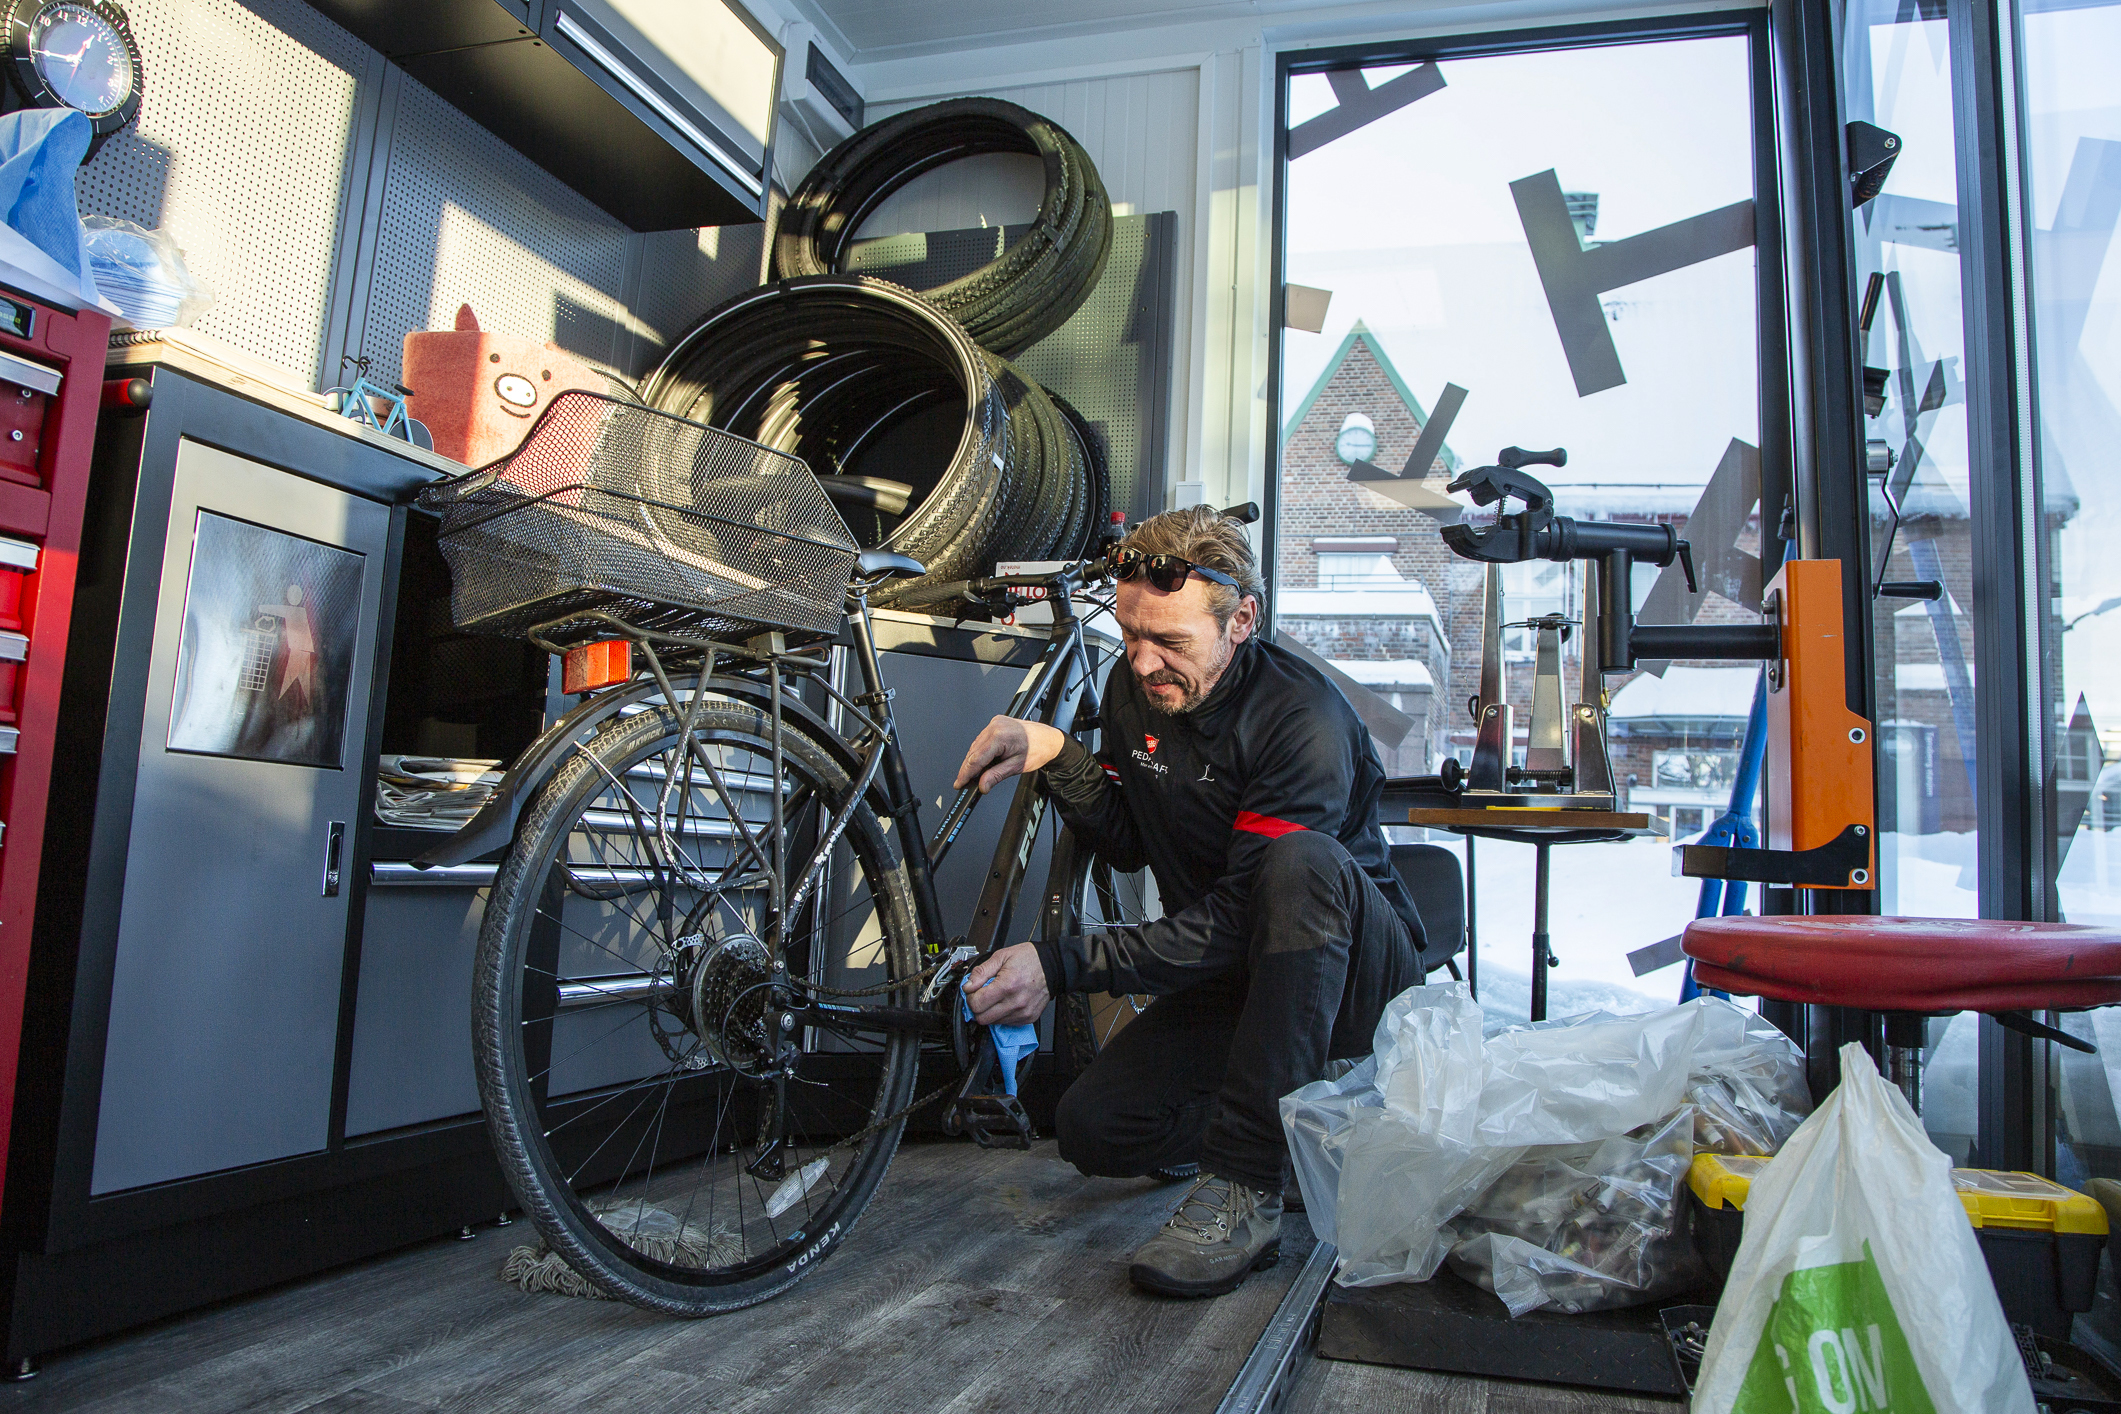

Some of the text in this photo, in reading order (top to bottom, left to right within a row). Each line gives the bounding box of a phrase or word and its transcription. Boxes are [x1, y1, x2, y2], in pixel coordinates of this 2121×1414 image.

[76, 15, 88, 27] 12
[934, 788, 969, 841] TRAVERSE
[786, 1221, 841, 1273] KENDA
[1209, 1253, 1241, 1264] GARMONT
